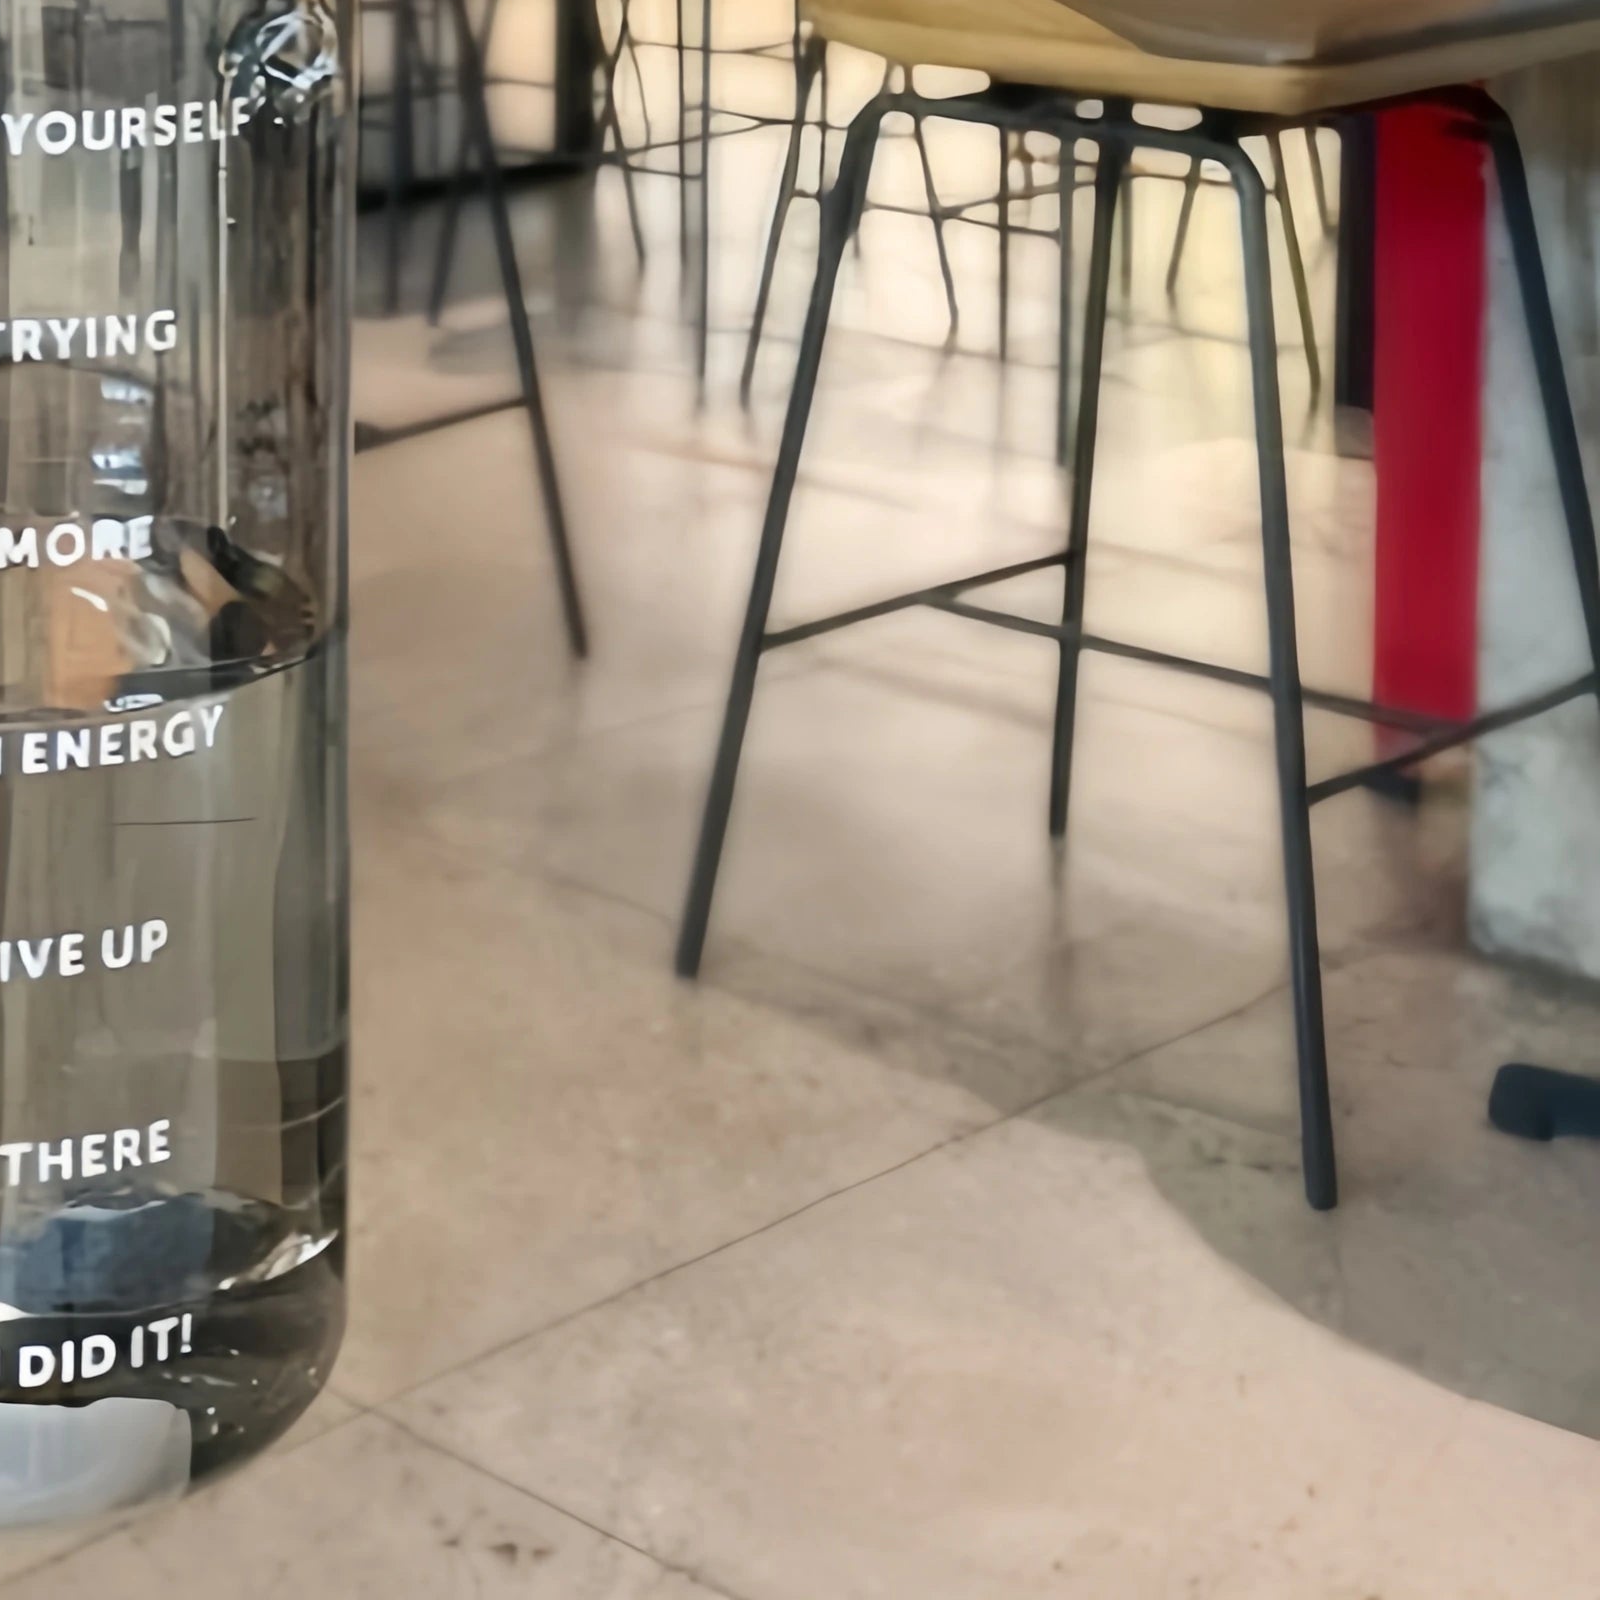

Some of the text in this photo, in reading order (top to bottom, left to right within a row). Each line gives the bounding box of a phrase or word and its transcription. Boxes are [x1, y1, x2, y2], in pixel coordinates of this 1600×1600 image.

[1, 96, 250, 155] YOURSELF
[20, 704, 224, 775] ENERGY
[101, 919, 169, 968] UP
[19, 1335, 118, 1388] DID
[130, 1313, 194, 1369] IT!
